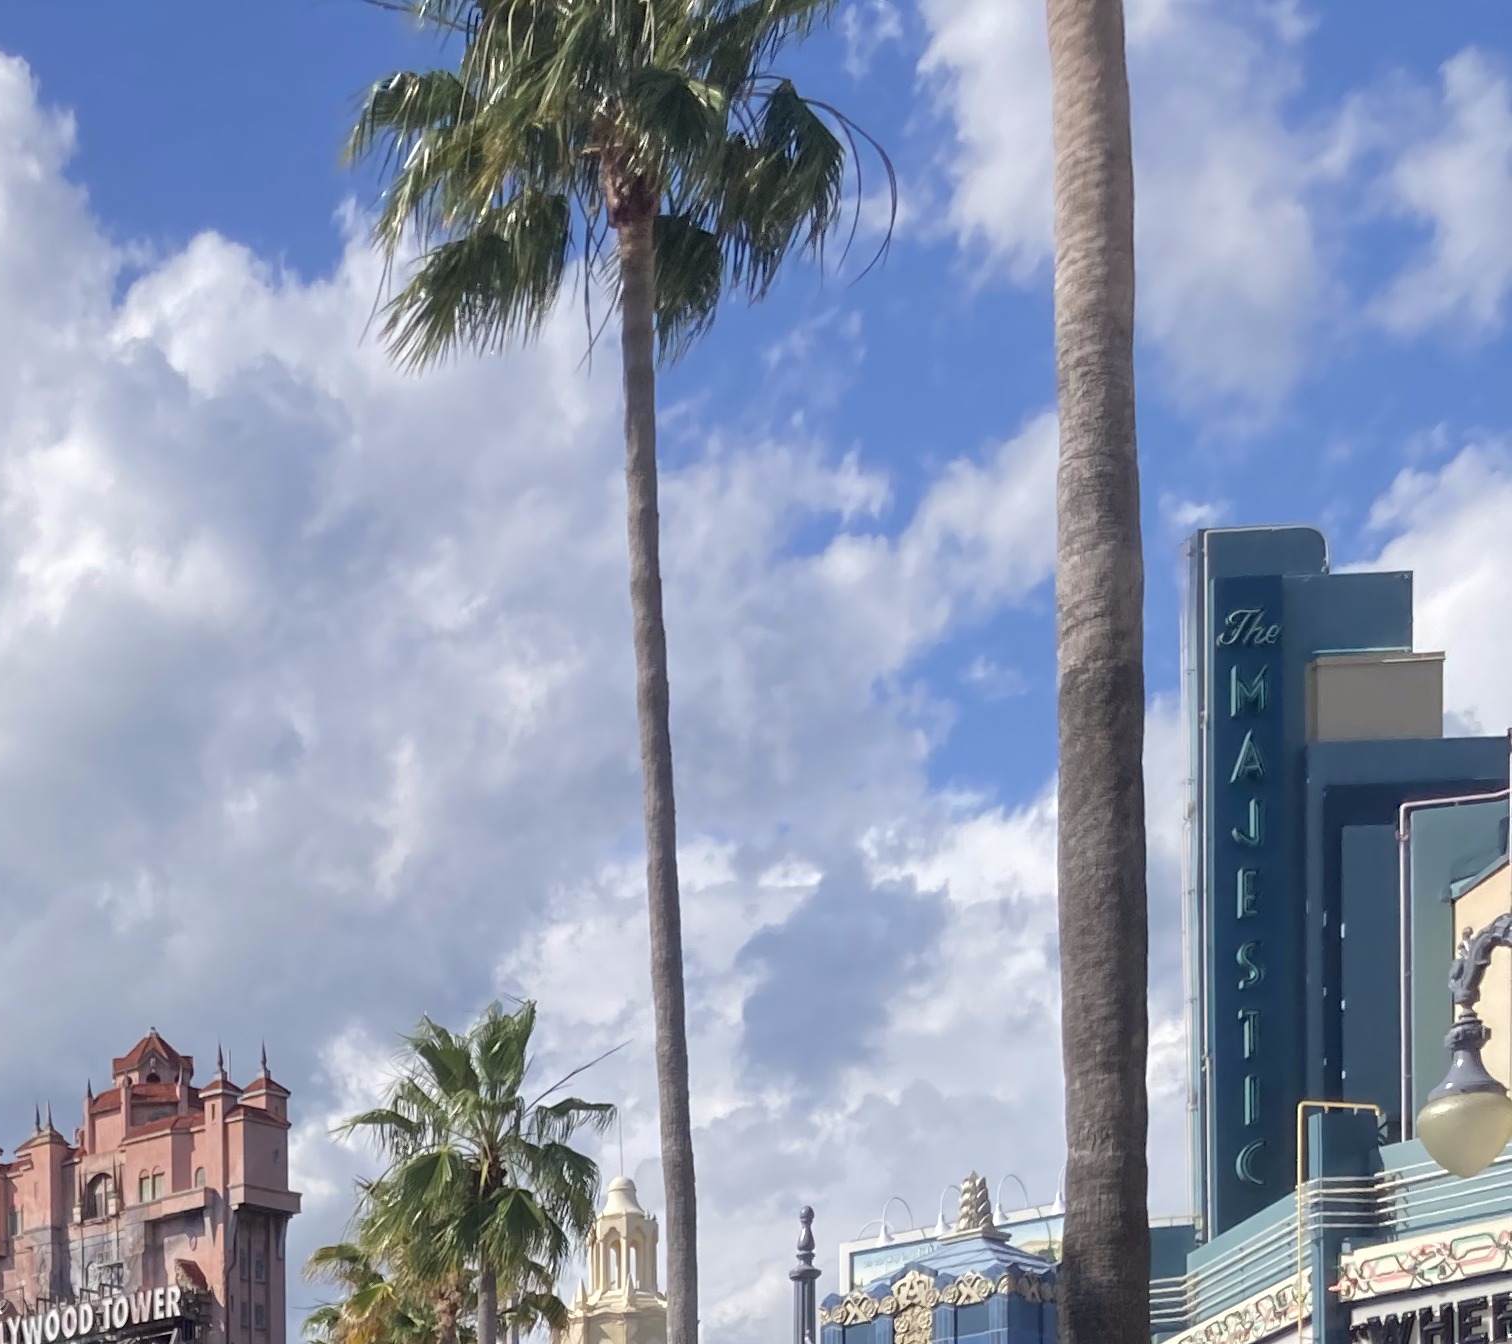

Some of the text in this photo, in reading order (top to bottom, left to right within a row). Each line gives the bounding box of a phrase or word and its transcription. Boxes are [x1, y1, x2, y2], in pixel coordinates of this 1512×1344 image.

[1216, 606, 1281, 648] The
[1229, 663, 1269, 1187] MAJESTIC
[102, 1286, 181, 1330] TOWER
